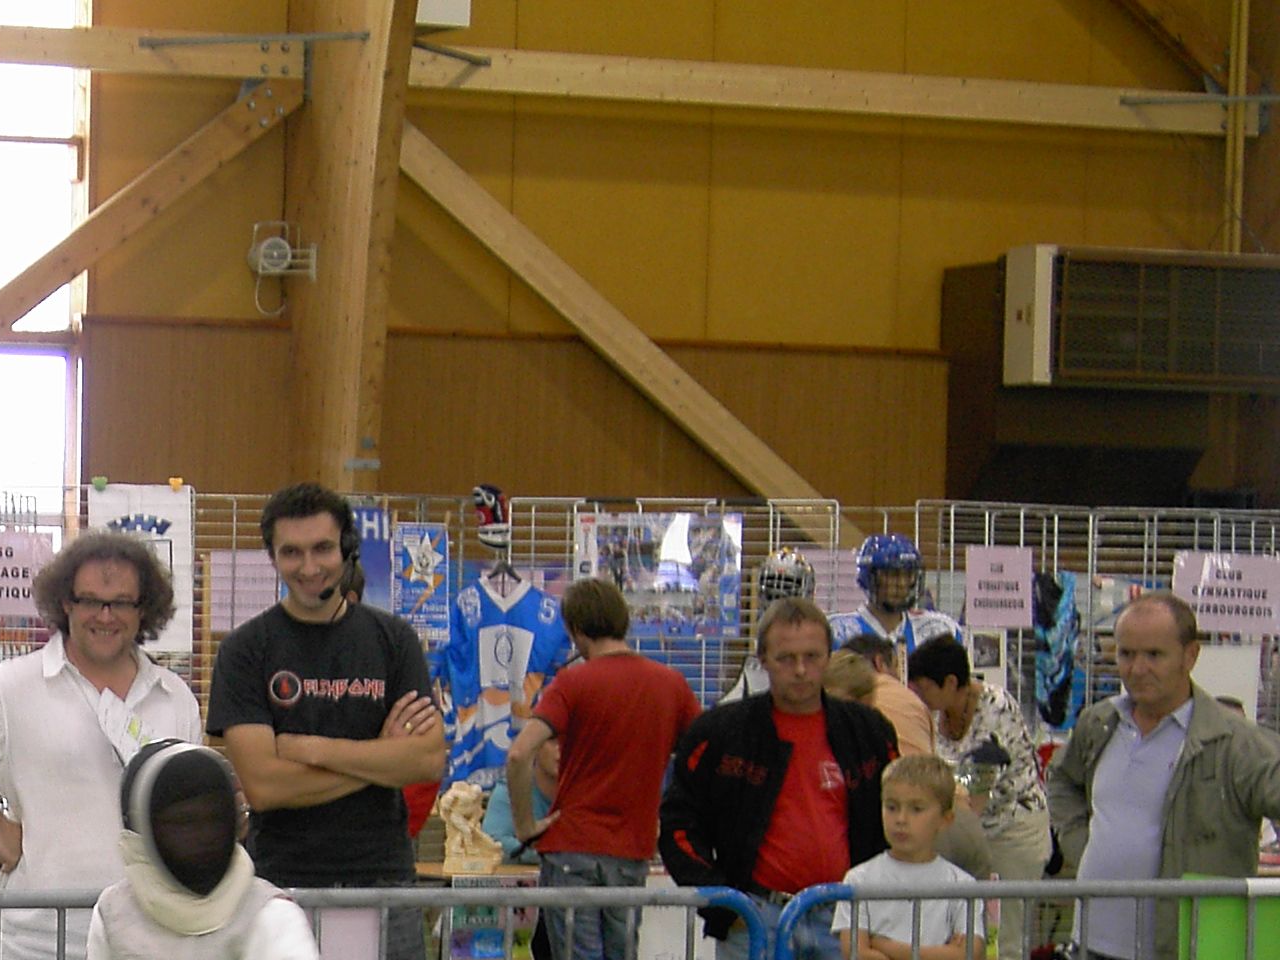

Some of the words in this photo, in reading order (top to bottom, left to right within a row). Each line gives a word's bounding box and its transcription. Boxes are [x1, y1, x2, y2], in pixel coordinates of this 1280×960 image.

[351, 510, 389, 540] HI
[1215, 569, 1242, 581] CLUB
[1191, 585, 1268, 600] GYMNASTIQUE
[1190, 602, 1273, 619] HERBOURGEOIS
